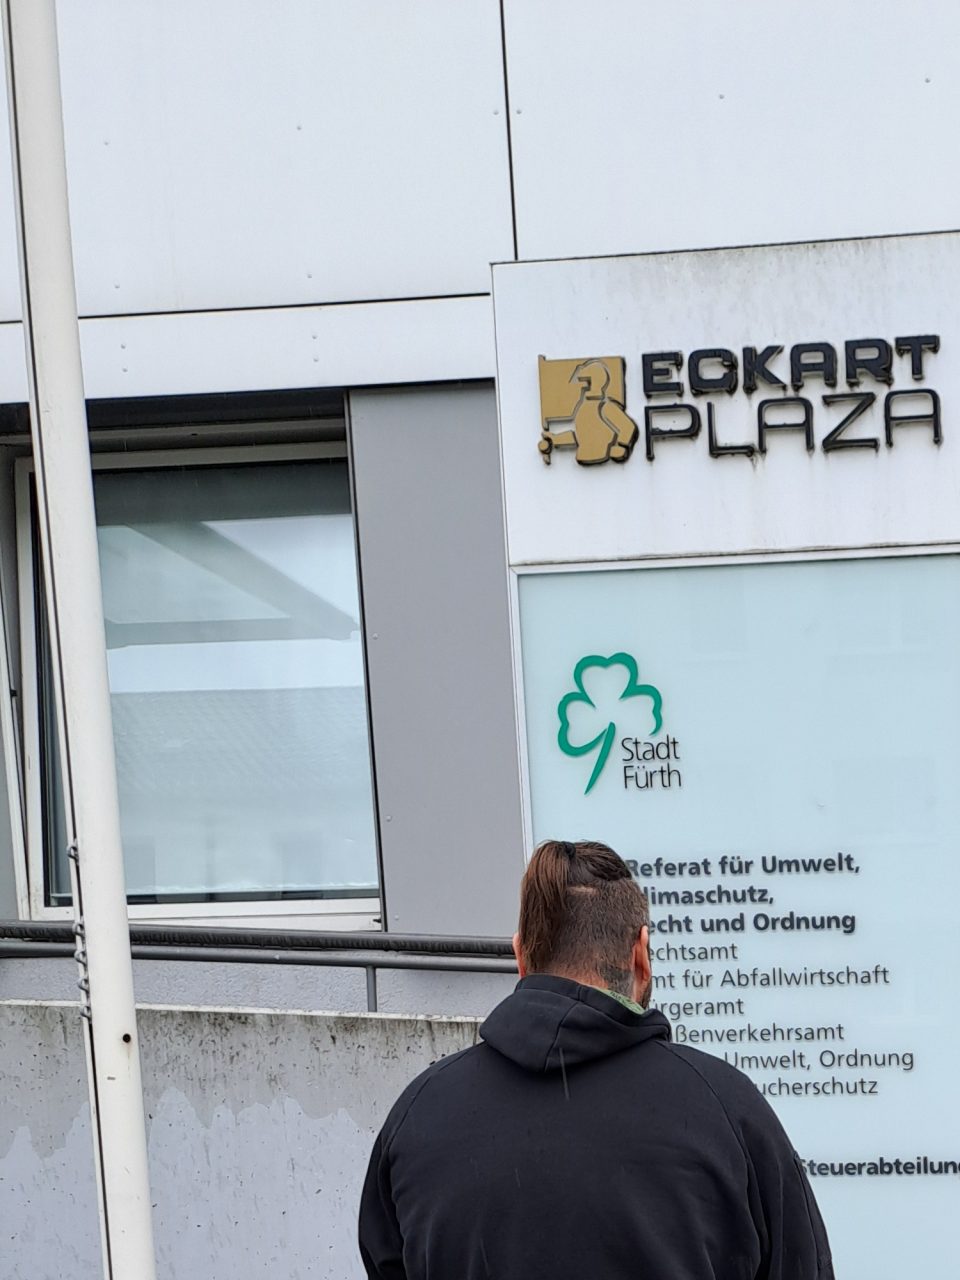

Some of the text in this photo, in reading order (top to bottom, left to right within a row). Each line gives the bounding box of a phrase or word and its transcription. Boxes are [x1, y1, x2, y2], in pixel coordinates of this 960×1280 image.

[641, 334, 940, 398] ECKART
[643, 388, 944, 462] PLAZA
[621, 734, 680, 761] Stadt
[623, 764, 682, 789] Fürth
[719, 855, 753, 875] für
[761, 853, 861, 875] Umwelt,
[643, 884, 774, 906] limaschutz,
[700, 912, 745, 933] und
[753, 911, 857, 933] Ordnung
[651, 965, 890, 989] mt für Abfallwirtschaft
[675, 1022, 844, 1043] ßenverkehrsamt
[819, 1049, 914, 1071] Ordnung
